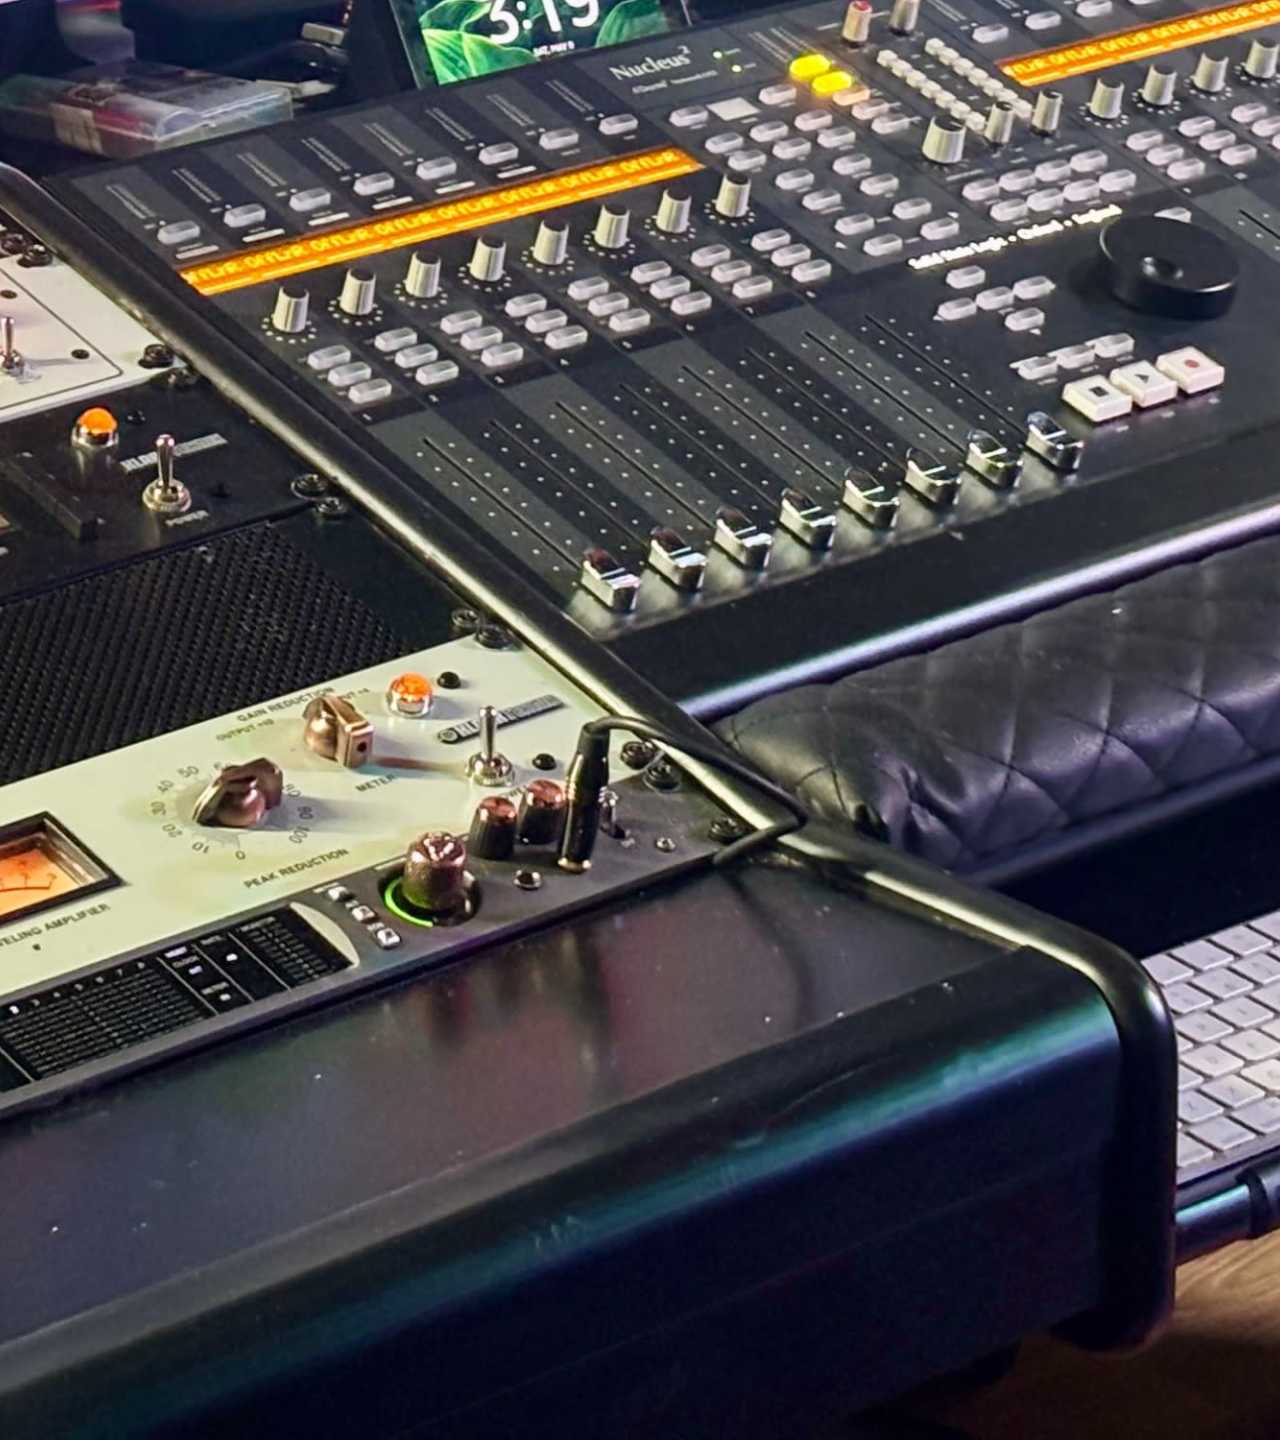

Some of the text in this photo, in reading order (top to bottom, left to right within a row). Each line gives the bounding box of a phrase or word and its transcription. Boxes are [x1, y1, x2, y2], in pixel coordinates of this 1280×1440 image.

[237, 708, 268, 723] GAIN
[178, 766, 200, 779] 50
[157, 779, 174, 794] 40
[150, 801, 167, 816] 30
[162, 823, 183, 838] 20
[191, 841, 210, 854] 10
[235, 849, 246, 861] 0
[243, 847, 349, 889] PEAK REDUCTION
[44, 903, 111, 932] AMPLIFIER
